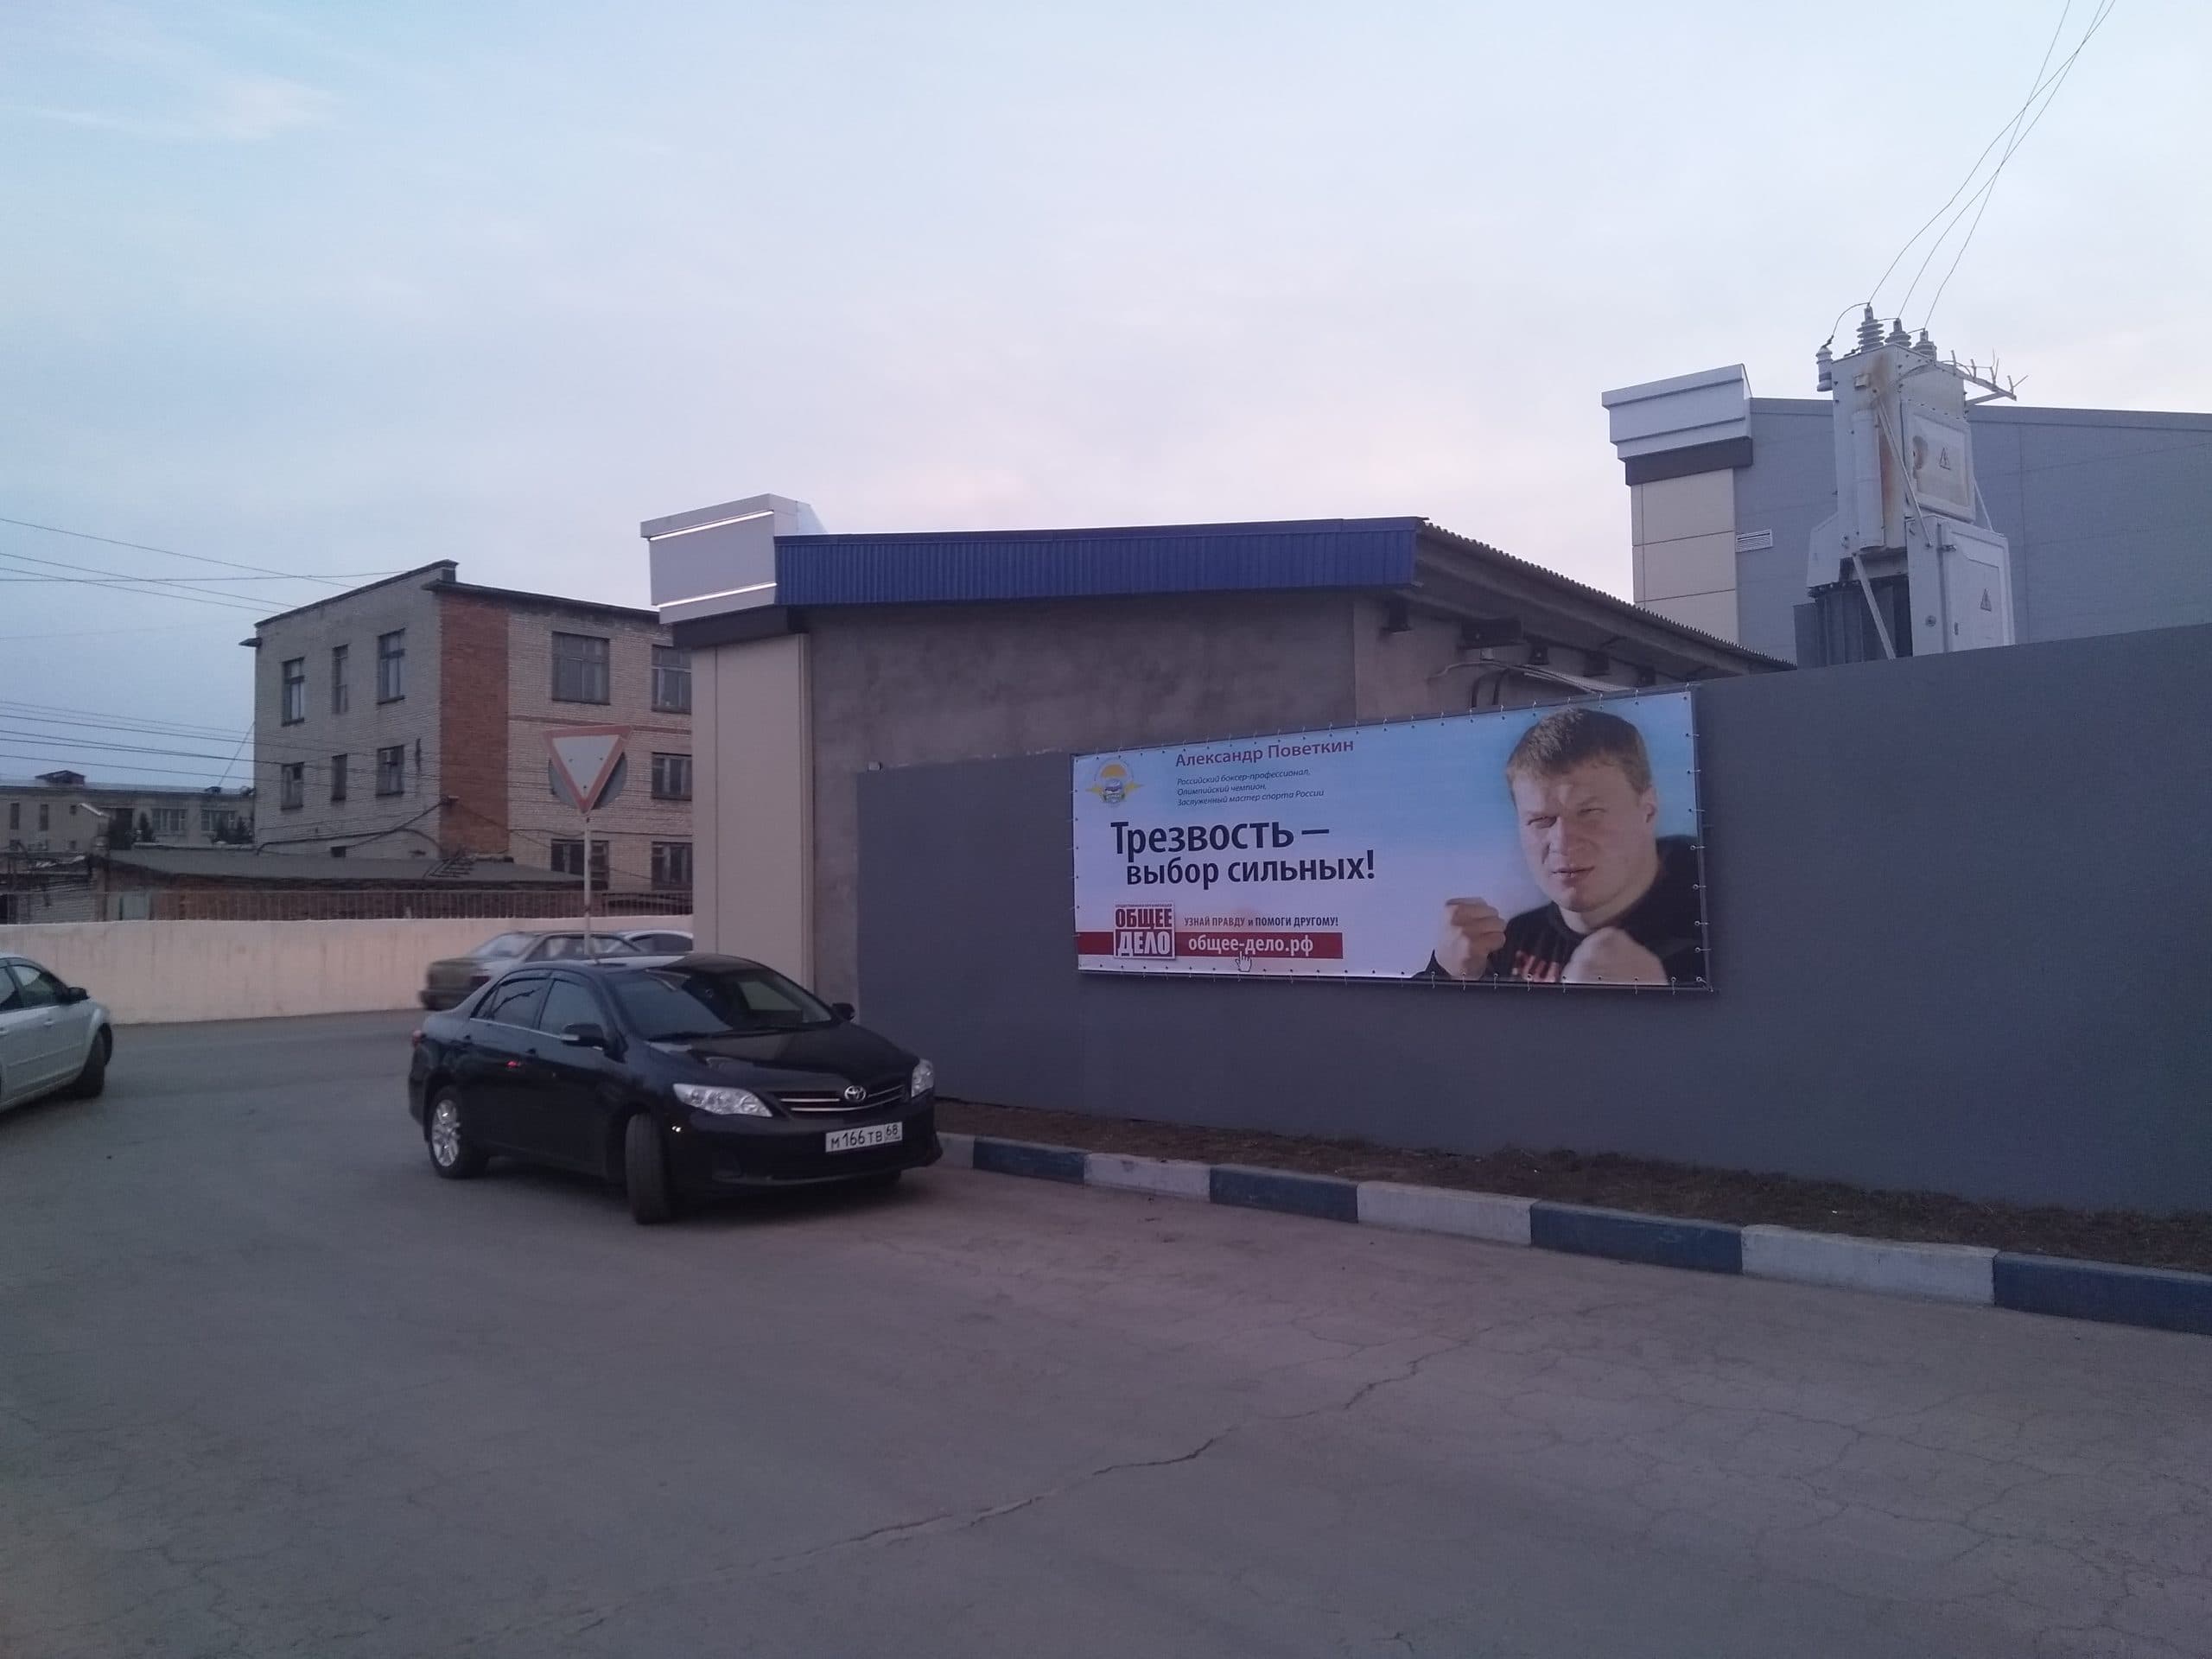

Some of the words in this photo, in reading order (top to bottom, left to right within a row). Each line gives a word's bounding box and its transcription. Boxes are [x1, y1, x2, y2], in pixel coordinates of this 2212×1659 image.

[1176, 749, 1263, 767] Александр
[1268, 741, 1354, 759] Поветкин
[1177, 774, 1220, 785] Российский
[1177, 785, 1230, 796] Олимпийский
[1178, 795, 1228, 806] Заслуженный
[1229, 794, 1261, 804] мастер
[1262, 792, 1294, 802] спорта
[1295, 790, 1325, 798] России
[1110, 821, 1294, 862] Трезвость
[1126, 856, 1219, 890] выбор
[1227, 849, 1376, 882] сильных!
[1116, 908, 1173, 930] ОБЩЕЕ
[1184, 916, 1210, 926] УЗНАЙ
[1211, 918, 1245, 927] ПРАВДУ
[1255, 917, 1292, 926] ПОМОГИ
[1294, 917, 1338, 928] ДРУГОМУ!
[1117, 931, 1171, 957] ДЕЛО
[1188, 934, 1313, 957] общее-дело.рф
